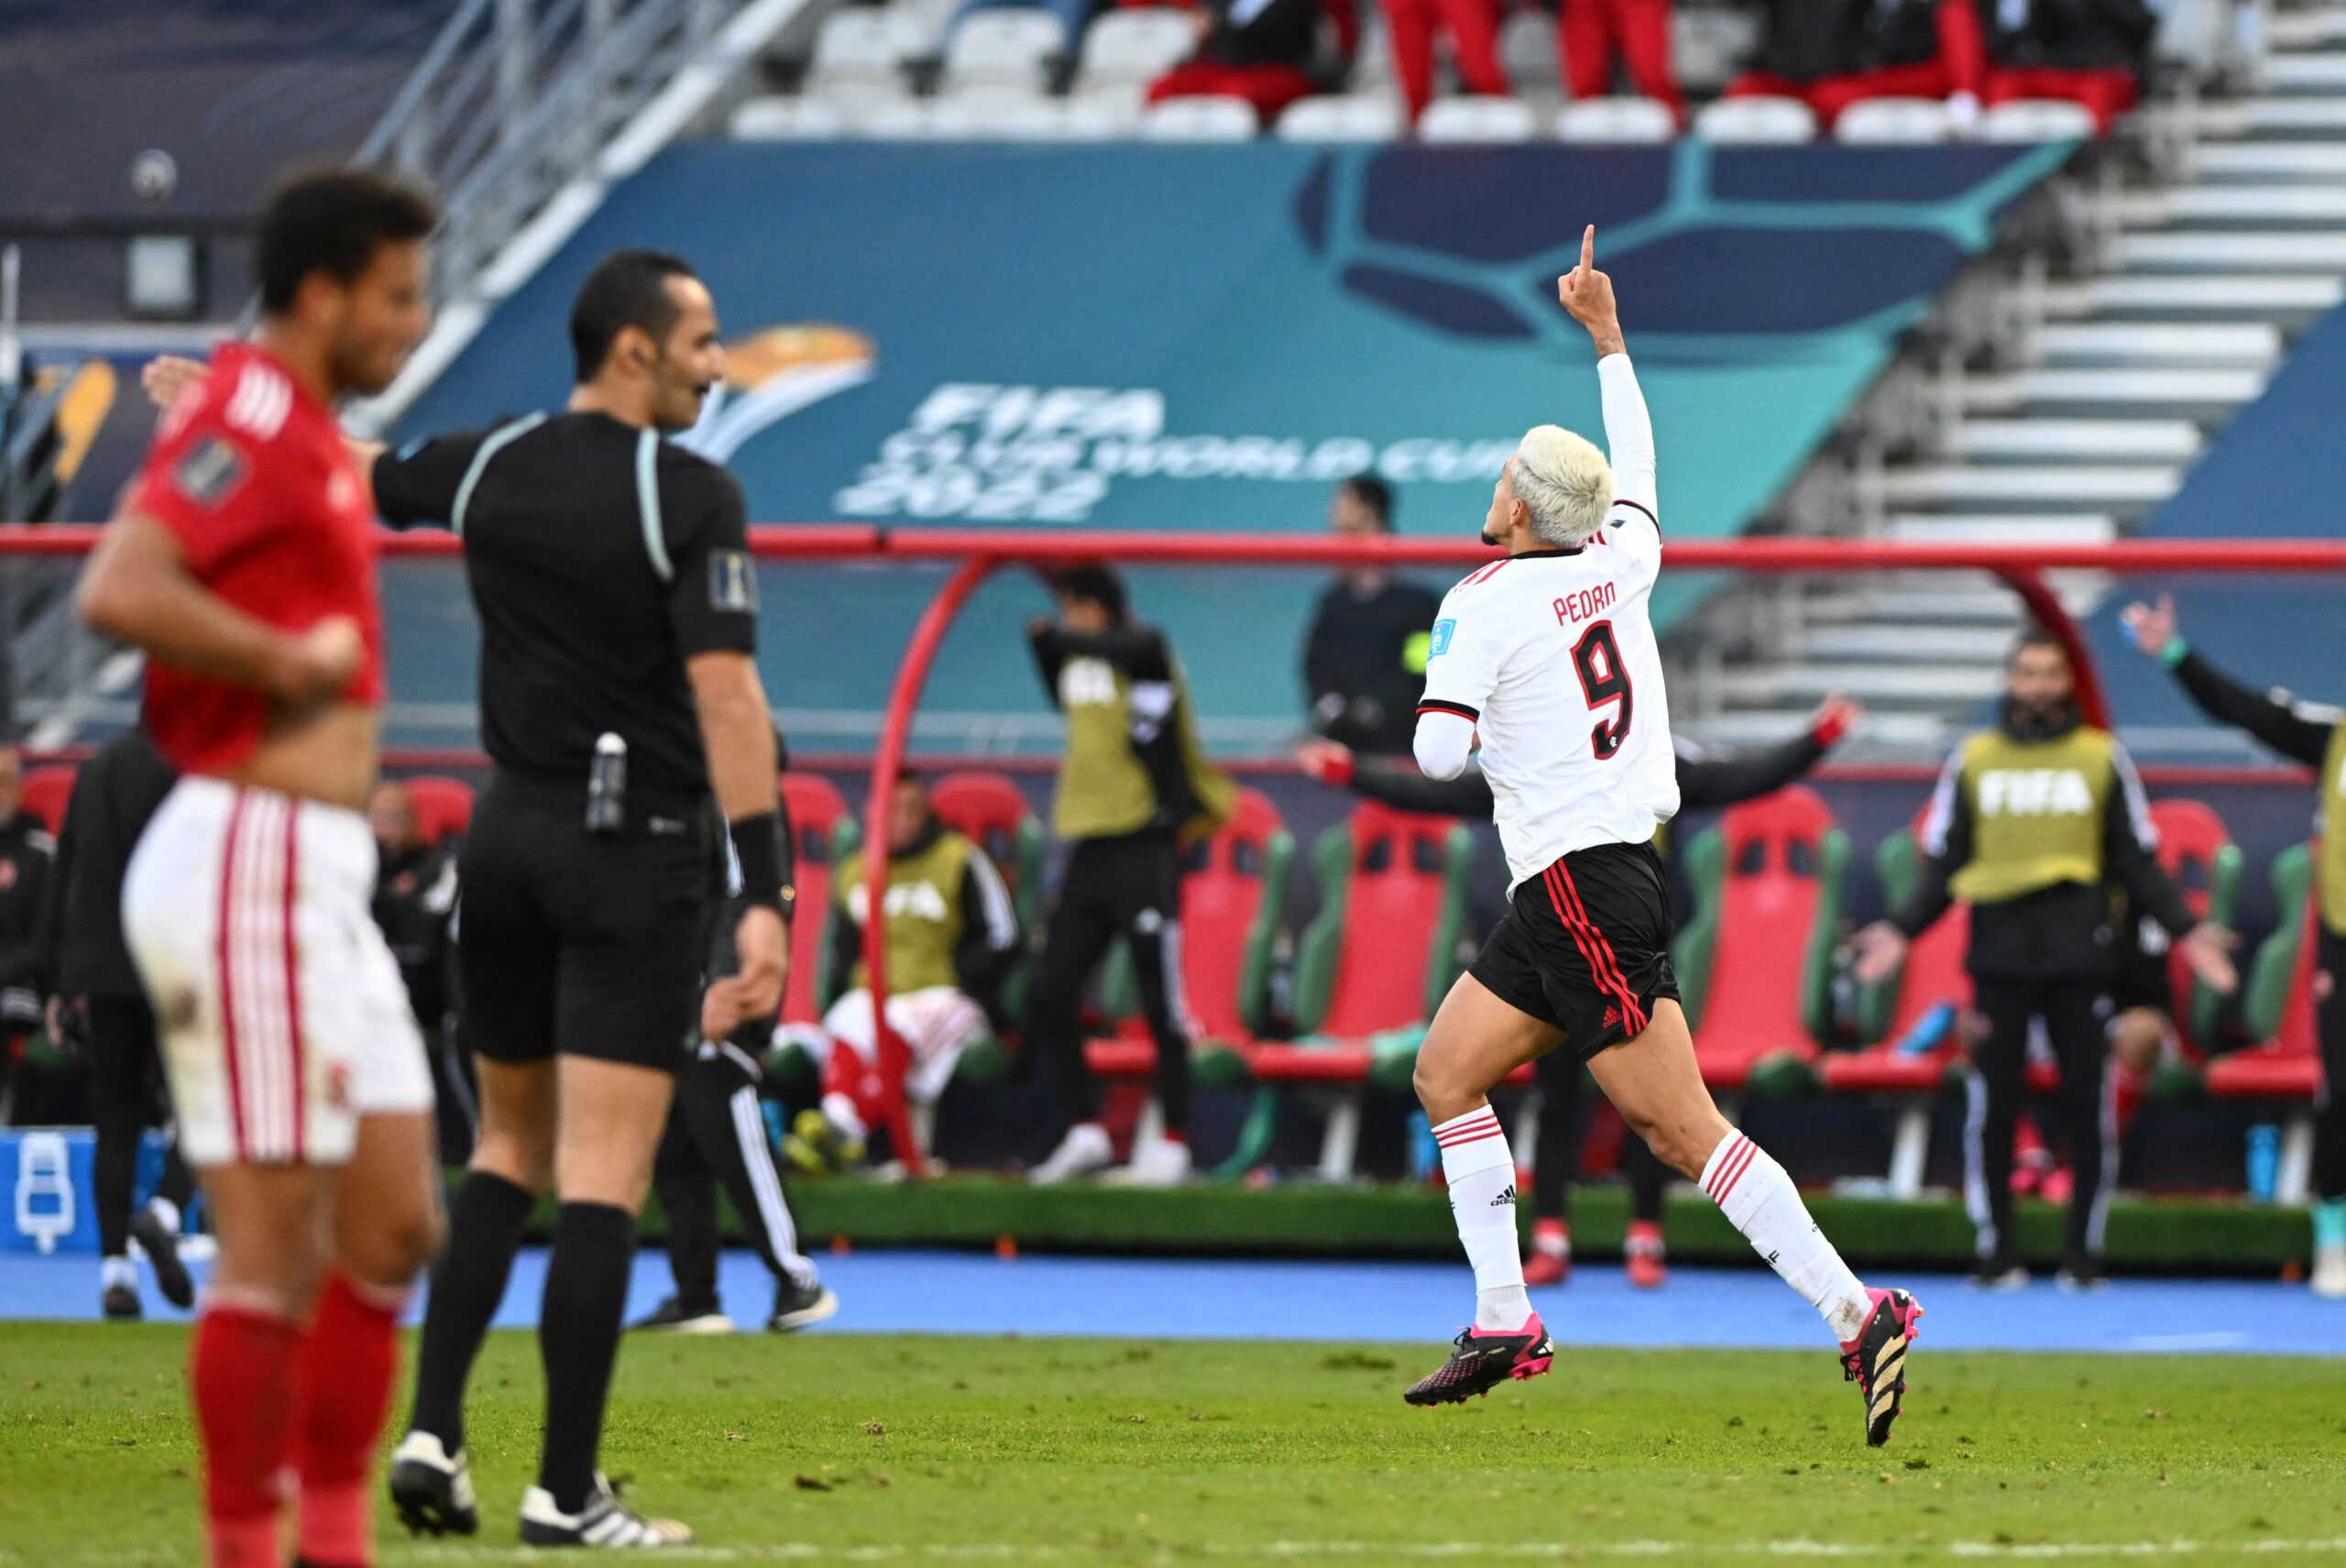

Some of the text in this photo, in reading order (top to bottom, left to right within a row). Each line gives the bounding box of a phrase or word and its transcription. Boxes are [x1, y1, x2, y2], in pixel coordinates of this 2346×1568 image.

[910, 382, 1166, 438] FIFA
[879, 428, 1085, 472] CLUB
[1093, 434, 1375, 480] WORLD
[834, 461, 1110, 522] 2022
[1570, 620, 1633, 760] 9
[1978, 767, 2095, 817] FIFA
[848, 880, 949, 922] FFA
